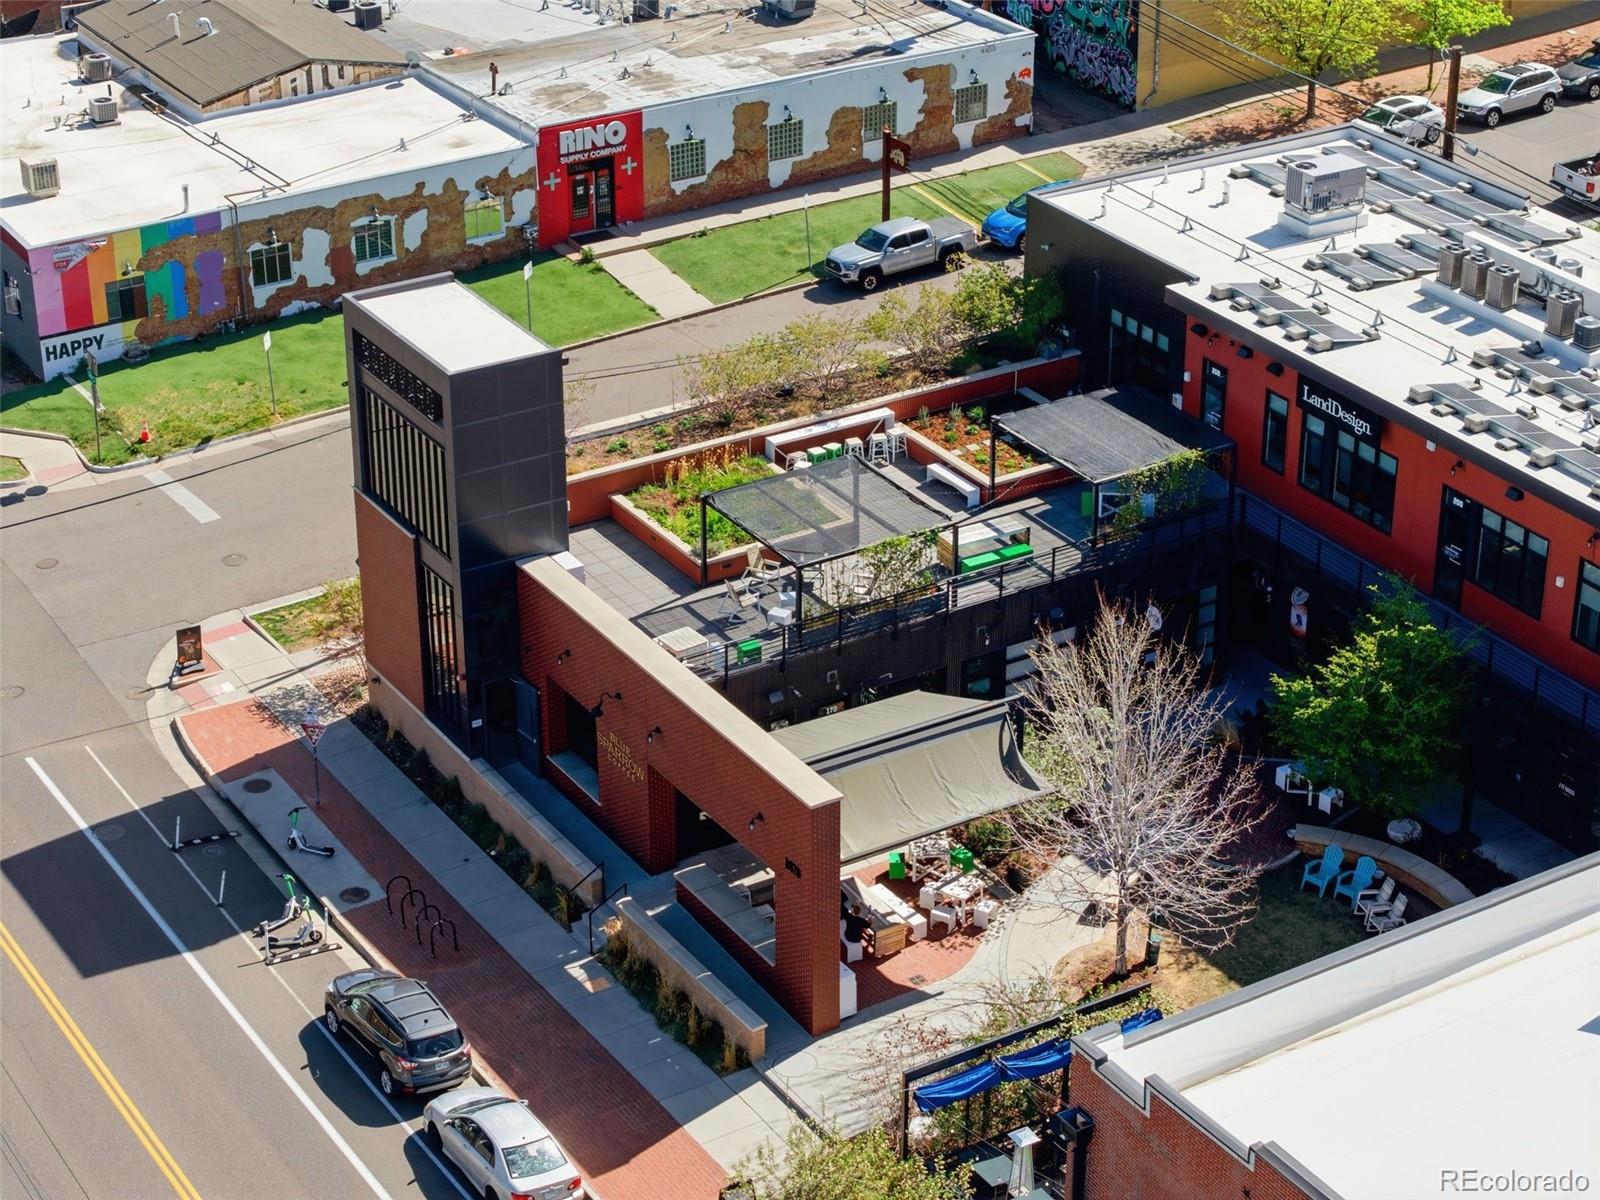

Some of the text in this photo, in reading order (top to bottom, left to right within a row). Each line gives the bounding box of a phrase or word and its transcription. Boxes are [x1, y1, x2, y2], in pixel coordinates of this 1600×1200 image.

[559, 120, 627, 155] RINO
[560, 144, 627, 165] SUPPLY COMPANY
[45, 333, 104, 362] HAPPY
[1303, 384, 1372, 436] LandDesign
[597, 731, 645, 781] SPARROW
[610, 731, 631, 758] BLUE
